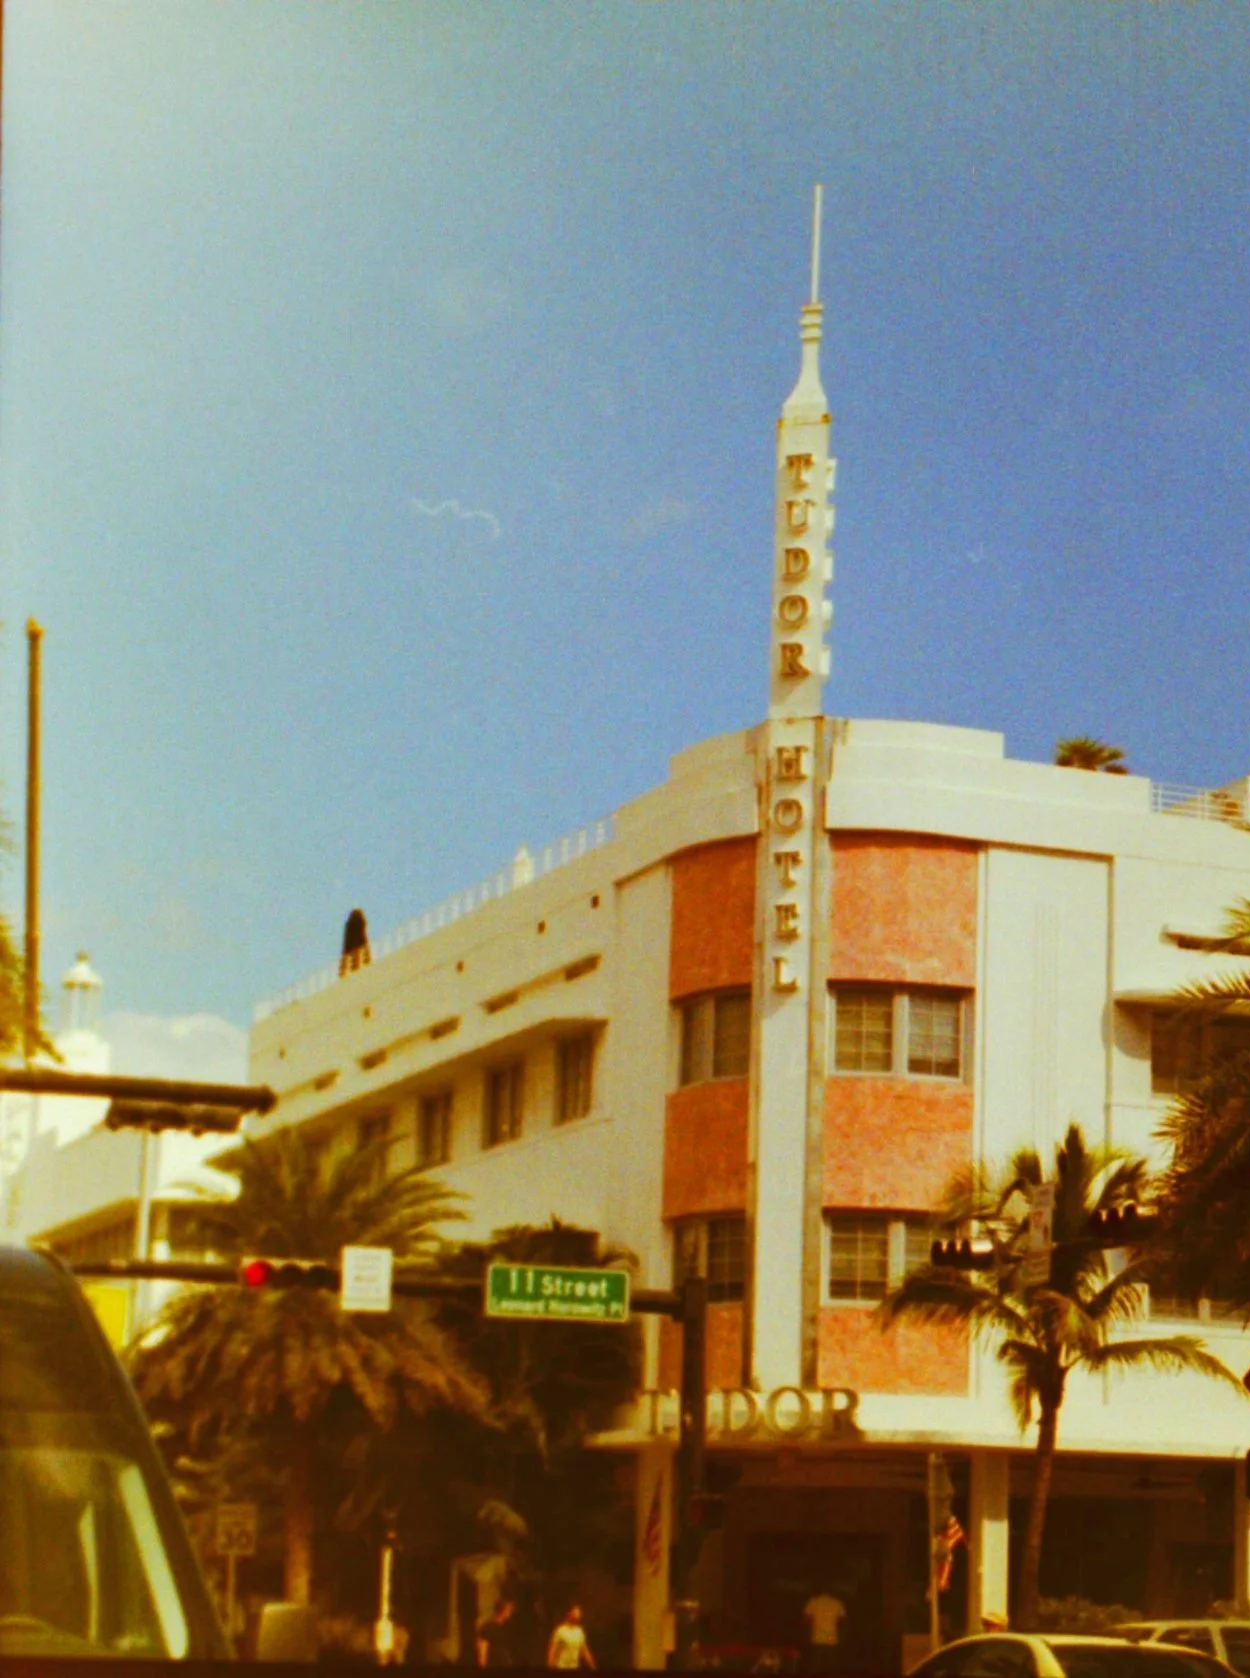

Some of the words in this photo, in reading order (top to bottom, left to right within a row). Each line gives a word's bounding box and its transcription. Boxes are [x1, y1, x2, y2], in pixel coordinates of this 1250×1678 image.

[778, 453, 815, 679] TUDOR
[772, 746, 808, 993] HOTEL
[509, 1269, 535, 1294] 11
[541, 1274, 608, 1298] Street
[637, 1386, 868, 1440] TDOR
